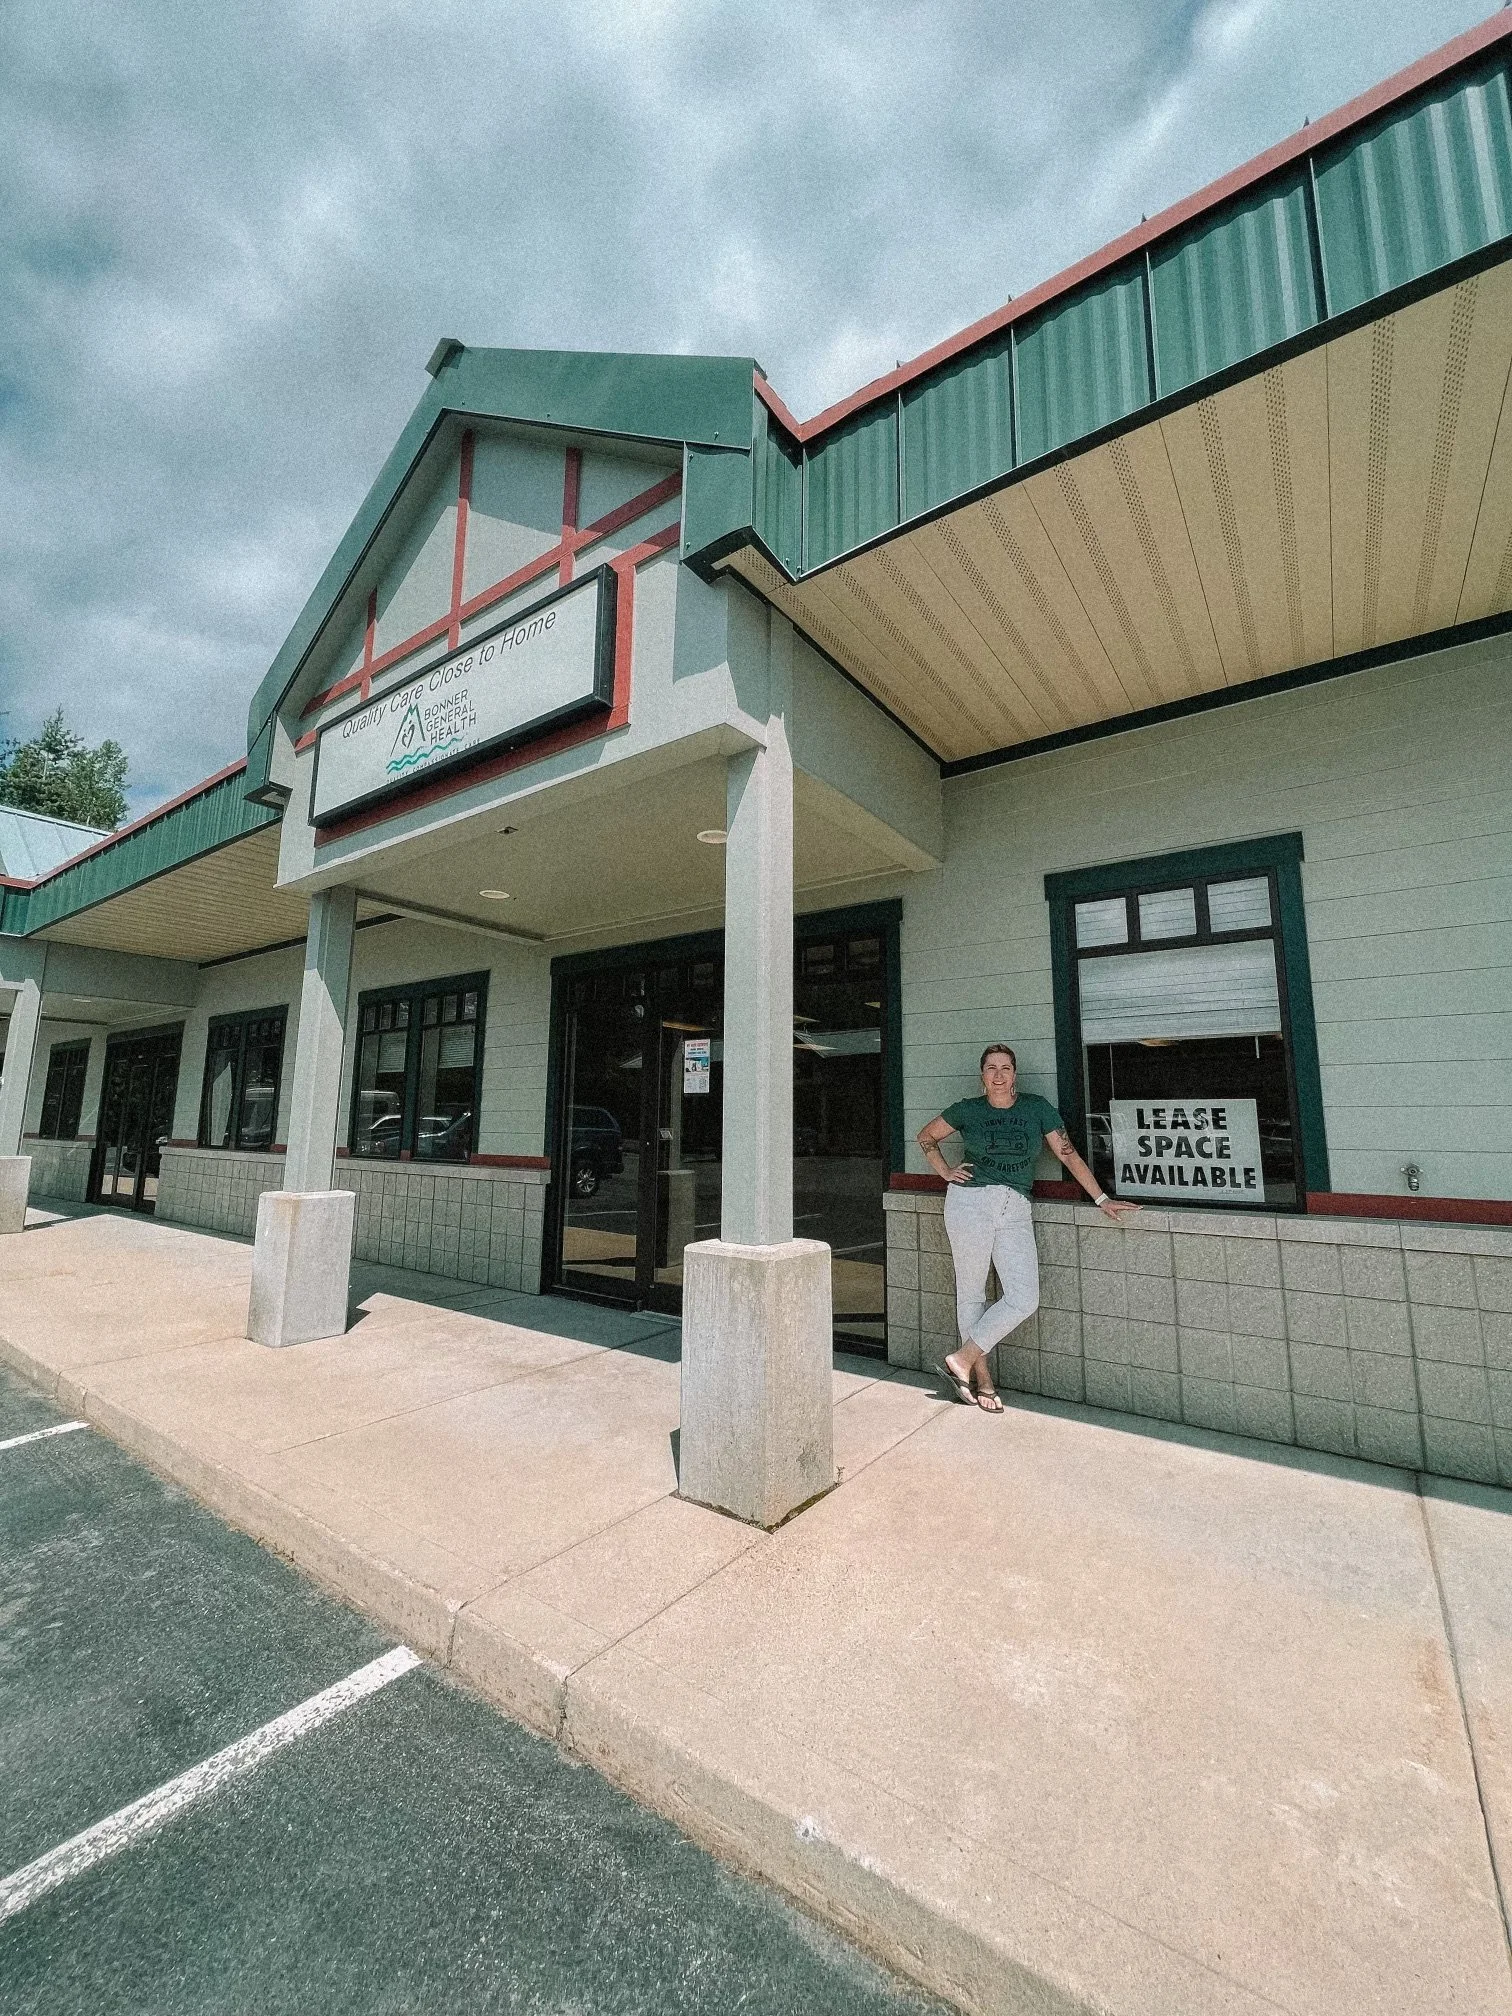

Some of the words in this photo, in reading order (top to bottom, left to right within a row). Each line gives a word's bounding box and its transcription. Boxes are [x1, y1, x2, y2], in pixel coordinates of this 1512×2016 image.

[342, 703, 387, 739] Quality
[390, 684, 424, 713] Care
[429, 656, 473, 692] Close
[478, 644, 496, 666] to
[500, 610, 556, 655] Home
[424, 689, 468, 721] BONNER
[426, 700, 475, 732] GENERAL
[430, 712, 476, 745] HEALTH
[1009, 1117, 1028, 1128] FAST
[1136, 1107, 1228, 1131] LEASE
[1137, 1135, 1231, 1160] SPACE
[1120, 1163, 1257, 1190] AVAILABLE
